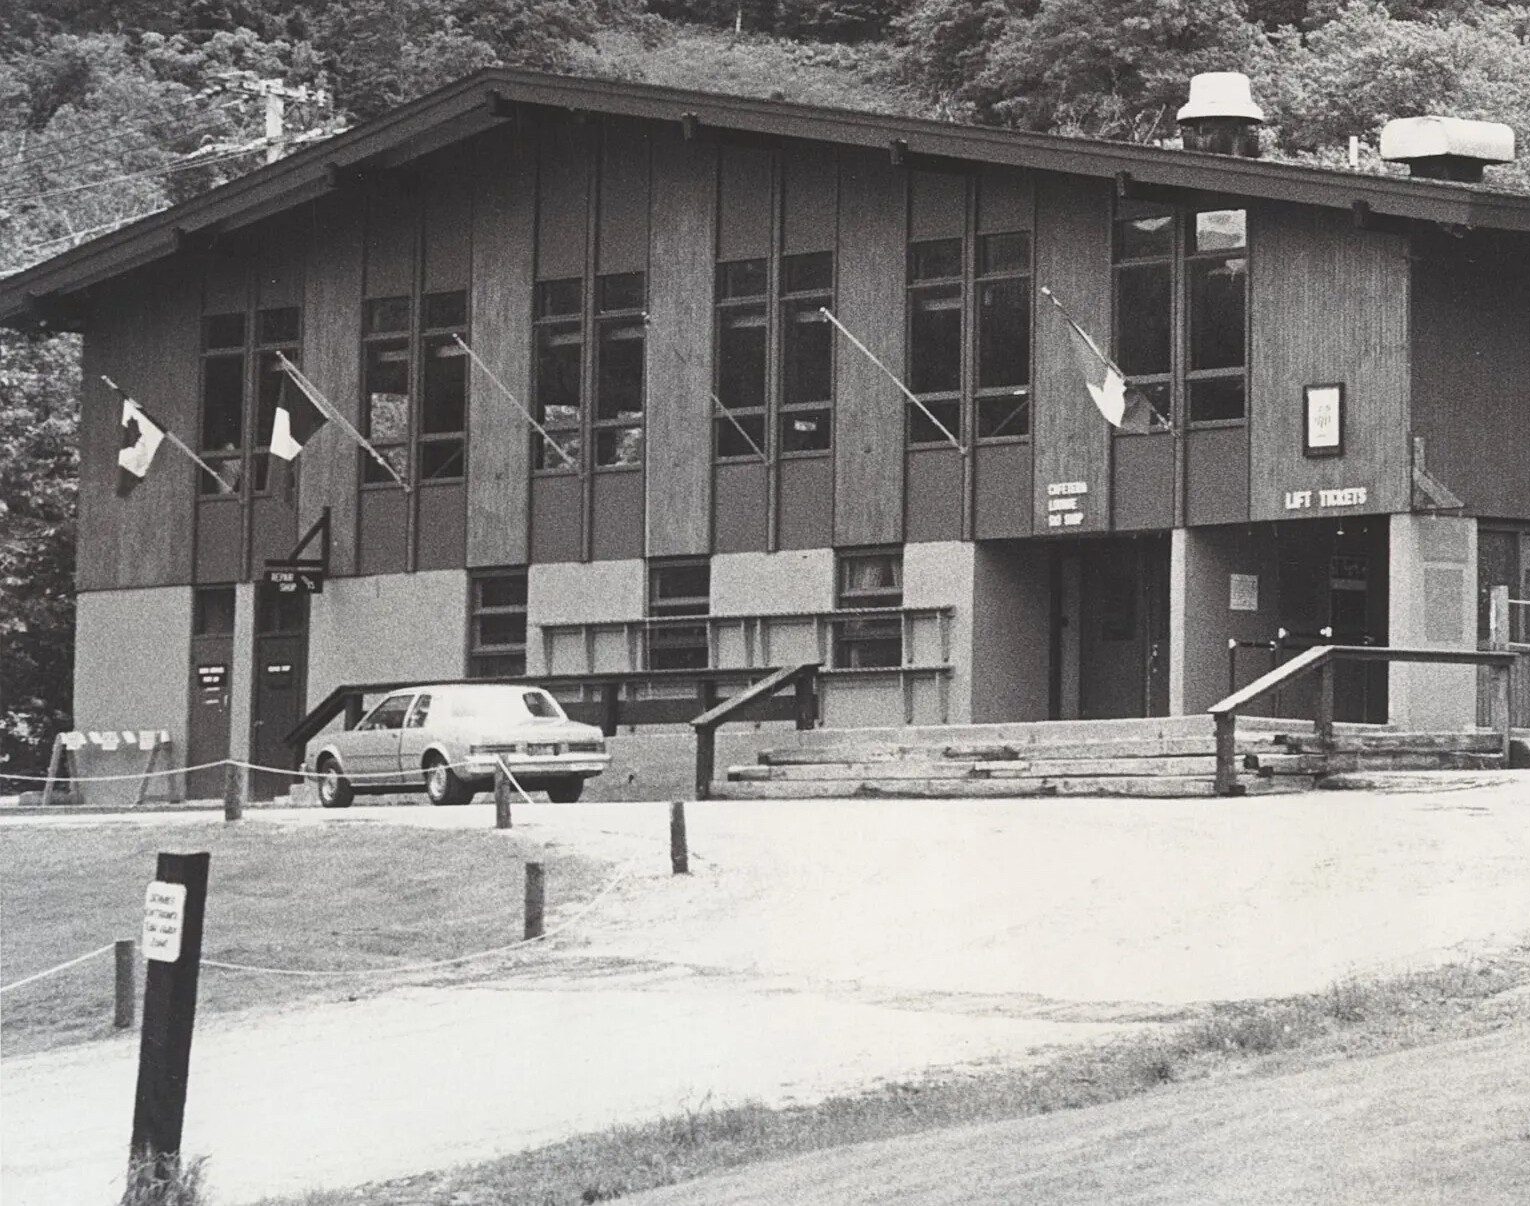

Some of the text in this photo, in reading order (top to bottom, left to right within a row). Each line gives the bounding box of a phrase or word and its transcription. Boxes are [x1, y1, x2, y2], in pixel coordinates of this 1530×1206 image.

[1285, 487, 1368, 510] LIFT TICKETS
[271, 572, 295, 583] REPAIR
[279, 582, 297, 593] SHOP
